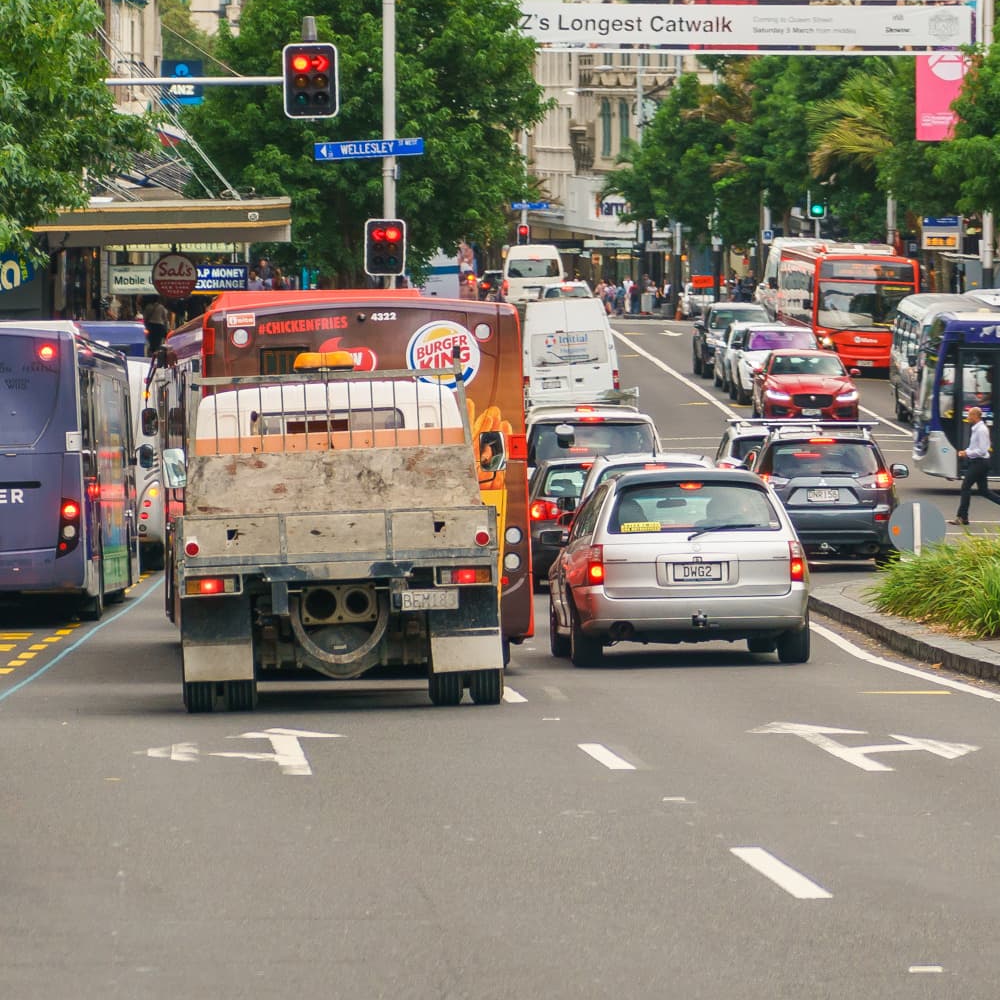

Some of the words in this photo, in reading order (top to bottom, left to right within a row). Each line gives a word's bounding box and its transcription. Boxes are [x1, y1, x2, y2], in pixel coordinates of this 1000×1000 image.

[558, 14, 643, 36] Longest
[650, 15, 733, 33] Catwalk
[753, 27, 784, 35] Saturday
[170, 84, 195, 96] ANZ
[340, 141, 394, 155] WELLESLEY
[159, 261, 193, 277] Sal's
[212, 268, 244, 278] MONEY
[114, 276, 145, 285] Mobile
[195, 279, 245, 289] EXCHANGE
[371, 312, 397, 321] 4322
[258, 316, 348, 335] #CHICKENFRIES
[559, 334, 588, 344] Initial
[416, 334, 468, 360] BURGER
[420, 346, 471, 370] KING
[683, 563, 712, 577] DWG2
